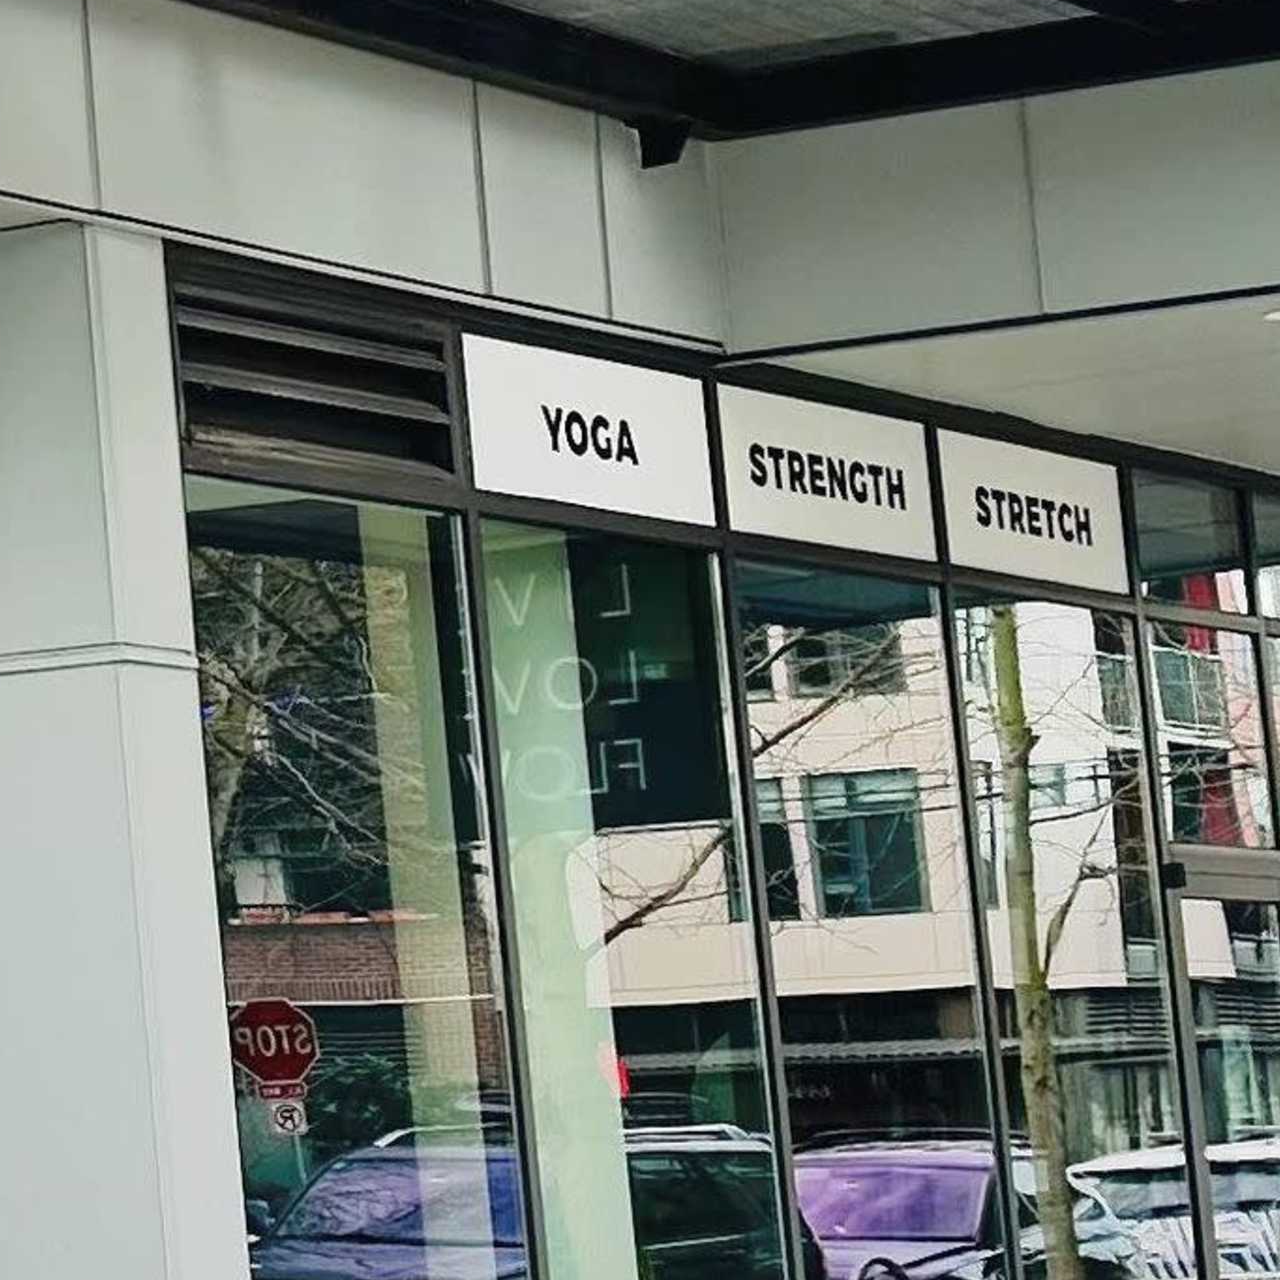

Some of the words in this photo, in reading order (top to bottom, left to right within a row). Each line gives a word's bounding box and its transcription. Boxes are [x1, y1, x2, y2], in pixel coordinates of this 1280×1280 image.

[540, 404, 639, 466] YOGA
[748, 442, 907, 511] STRENGTH
[974, 485, 1094, 547] STRETCH
